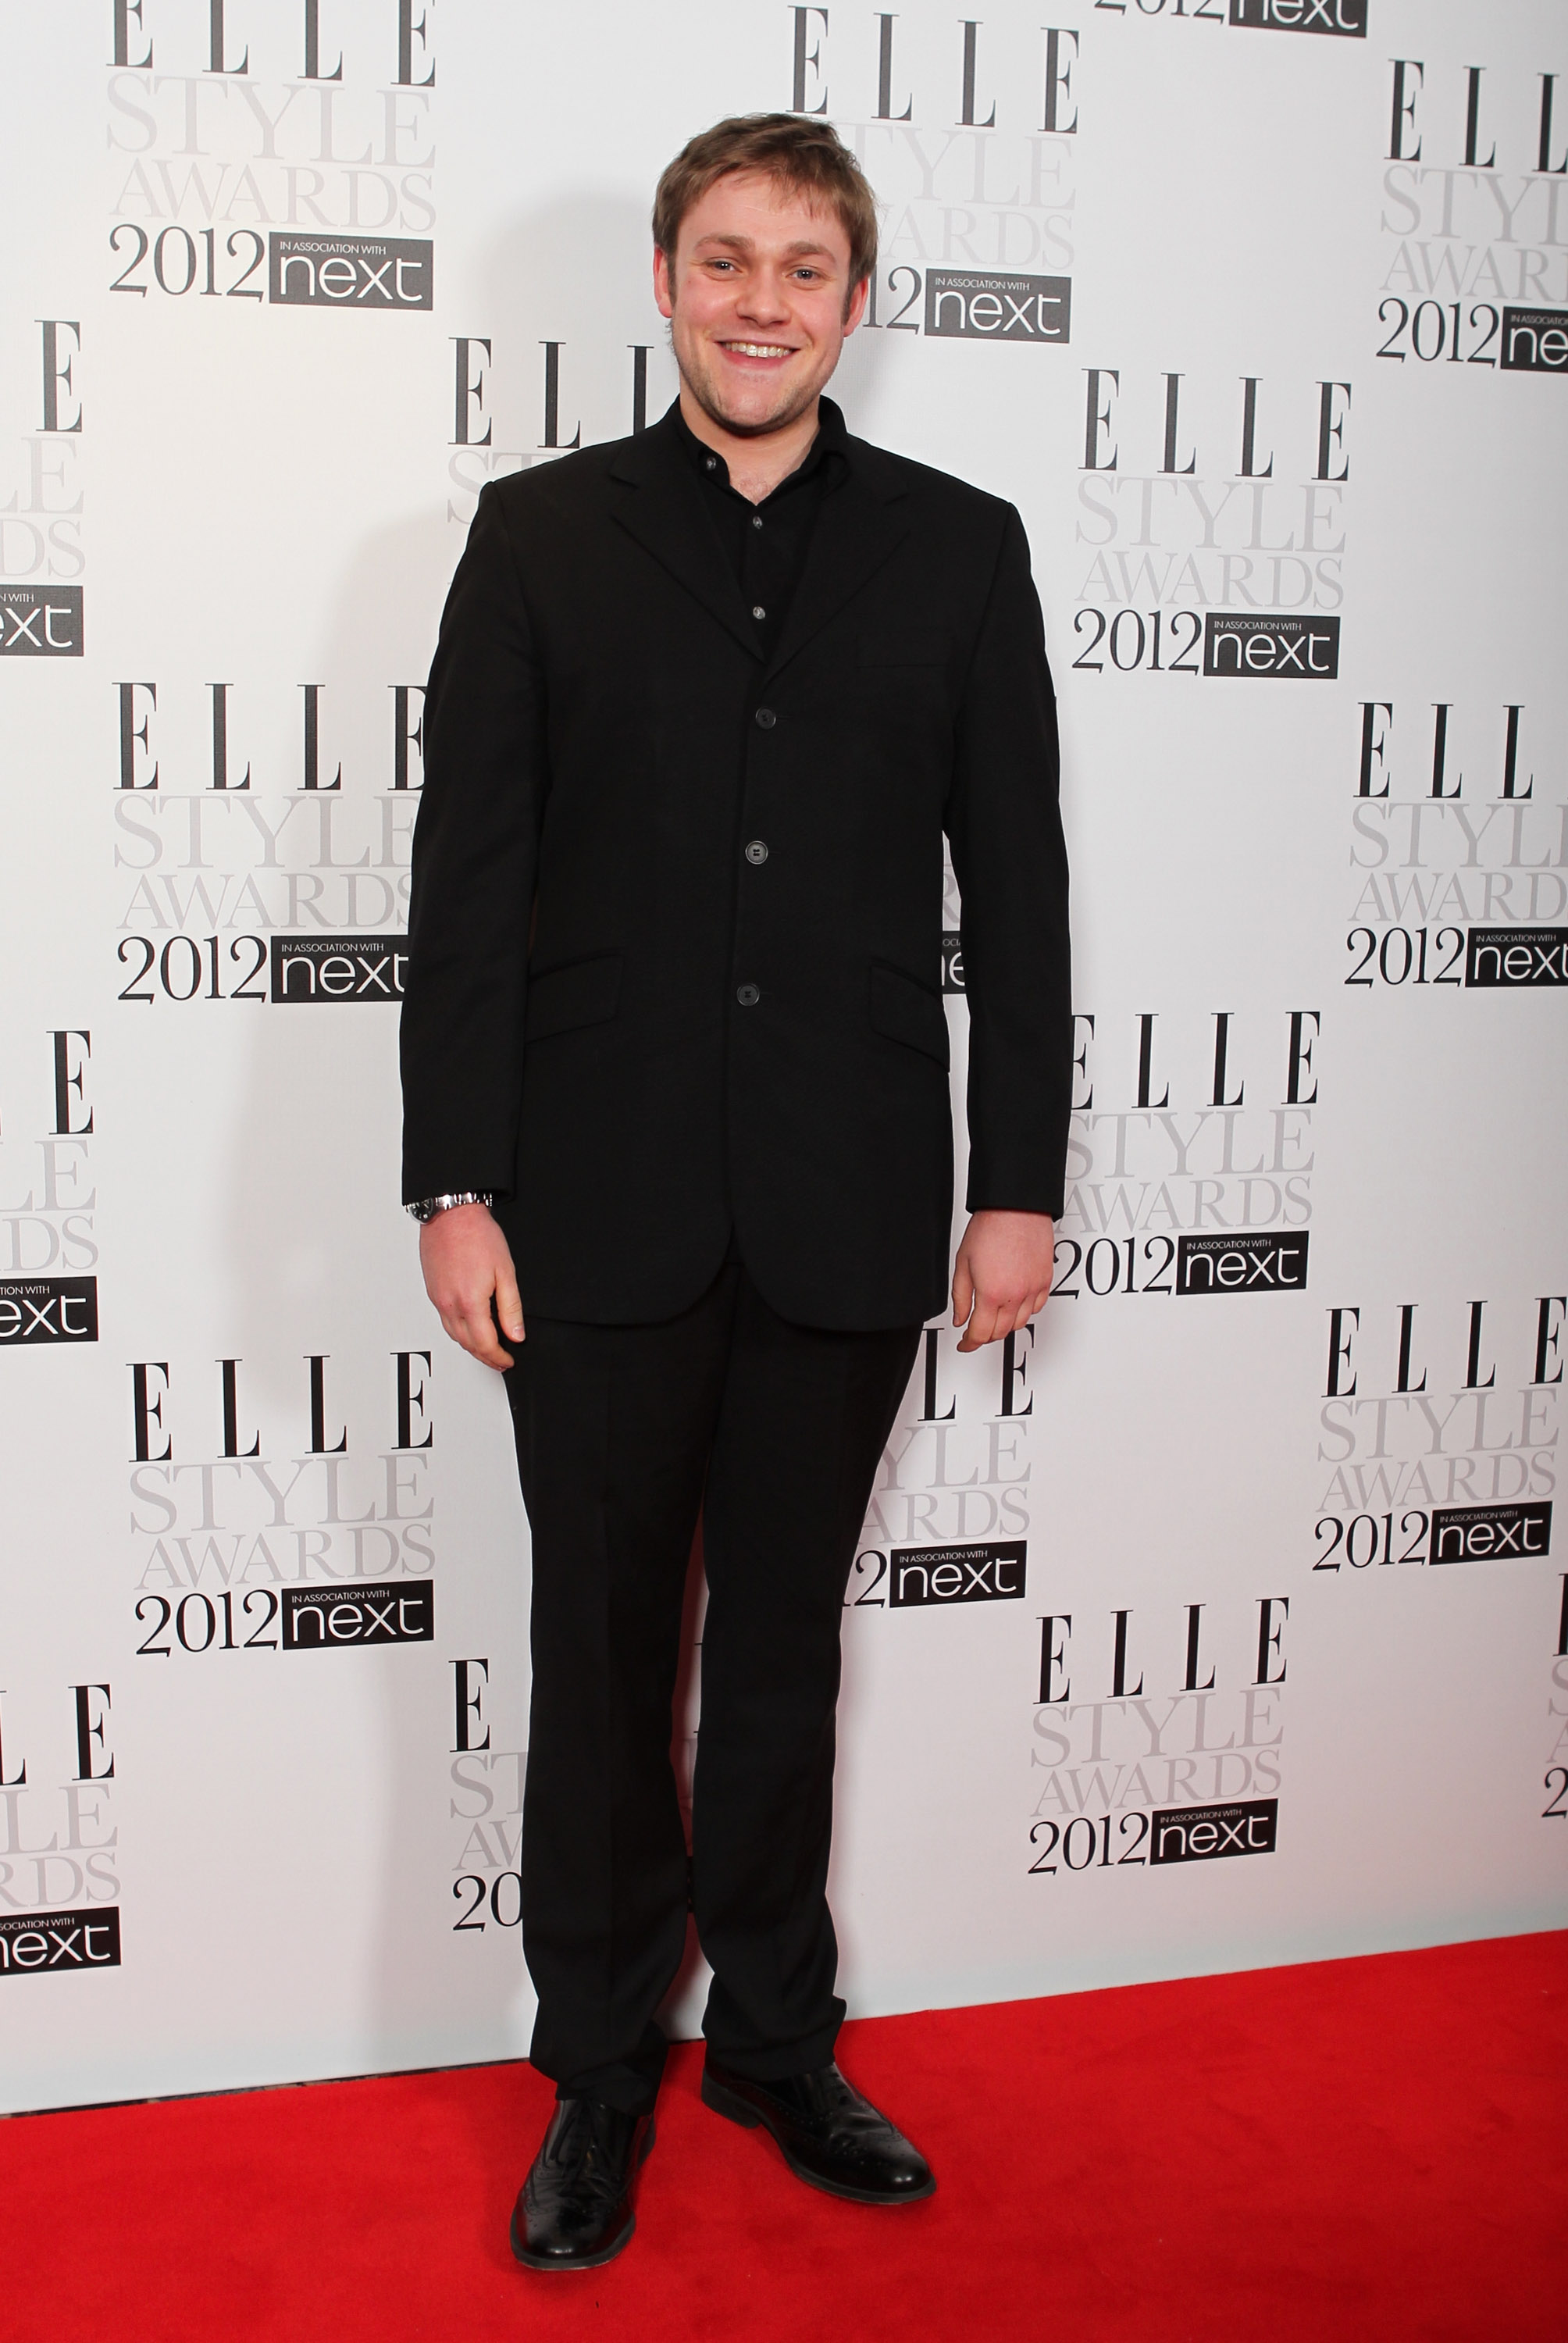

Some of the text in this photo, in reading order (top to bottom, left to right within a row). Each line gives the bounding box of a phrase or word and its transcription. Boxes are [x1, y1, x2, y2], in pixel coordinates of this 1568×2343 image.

[106, 0, 436, 87] ELLE
[786, 5, 1079, 134] ELLE
[106, 73, 436, 169] STYLE
[1384, 59, 1568, 173] ELL
[109, 158, 437, 233] AWARDS
[834, 122, 1077, 210] TYLE
[875, 205, 1075, 269] ARDS
[1381, 165, 1568, 247] STYL
[109, 224, 265, 303] 2012
[280, 241, 386, 255] IN ASSOCIATION WITH
[280, 255, 422, 301] next
[1378, 241, 1568, 303] AWAR
[863, 266, 922, 334] 12
[935, 291, 1061, 334] next
[947, 279, 1006, 290] ASSOCIATION
[1007, 282, 1029, 291] WITH
[1376, 298, 1499, 368] 2012
[1509, 327, 1568, 365] ne
[1521, 315, 1568, 325] ASSOCIATIO
[1078, 369, 1352, 481] ELLE
[1075, 475, 1346, 553] STYLE
[8, 594, 34, 602] WITH
[1074, 550, 1344, 610] AWARDS
[1072, 608, 1203, 676] 2012
[1213, 633, 1330, 671] next
[1225, 621, 1279, 629] ASSOCIATION
[112, 683, 428, 790] ELLE
[1352, 702, 1568, 799] ELL
[1348, 872, 1568, 922] AWARD
[117, 936, 267, 1004] 2012
[283, 954, 408, 994] next
[294, 943, 358, 952] ASSOCIATION
[1344, 927, 1466, 988] 2012
[1064, 1109, 1315, 1179] STYLE
[1054, 1177, 1313, 1234] AWARDS
[25, 1286, 50, 1294] WITH
[1049, 1236, 1176, 1299] 2012
[1185, 1248, 1299, 1287] next
[0, 1296, 87, 1337] ext
[1321, 1296, 1567, 1398] ELLE
[917, 1323, 1035, 1421] LE
[126, 1351, 433, 1463] ELLE
[1317, 1387, 1559, 1462] STYLE
[879, 1421, 1032, 1491] YLE
[1315, 1450, 1556, 1513] AWARDS
[130, 1453, 434, 1534] STYLE
[859, 1488, 1030, 1544] ARDS
[1449, 1512, 1498, 1522] ASSOCIATION
[1499, 1510, 1518, 1519] WITH
[134, 1524, 436, 1590] AWARDS
[911, 1552, 965, 1562] ASSOCIATION
[967, 1550, 988, 1559] WITH
[1312, 1510, 1429, 1573] 2012
[1438, 1517, 1543, 1557] next
[304, 1592, 365, 1602] ASSOCIATION
[900, 1558, 1017, 1599] next
[135, 1589, 279, 1657] 2012
[293, 1599, 424, 1642] next
[1032, 1597, 1289, 1704] ELLE
[1030, 1687, 1284, 1768] STYLE
[1030, 1749, 1282, 1817] AWARDS
[1028, 1812, 1150, 1875] 2012
[1159, 1816, 1268, 1857] next
[1171, 1810, 1221, 1822] ASSOCIATION
[1222, 1809, 1242, 1817] WITH
[0, 1917, 75, 1931] SOCIATION WITH
[452, 1872, 524, 1932] 20
[0, 1925, 111, 1968] ext
